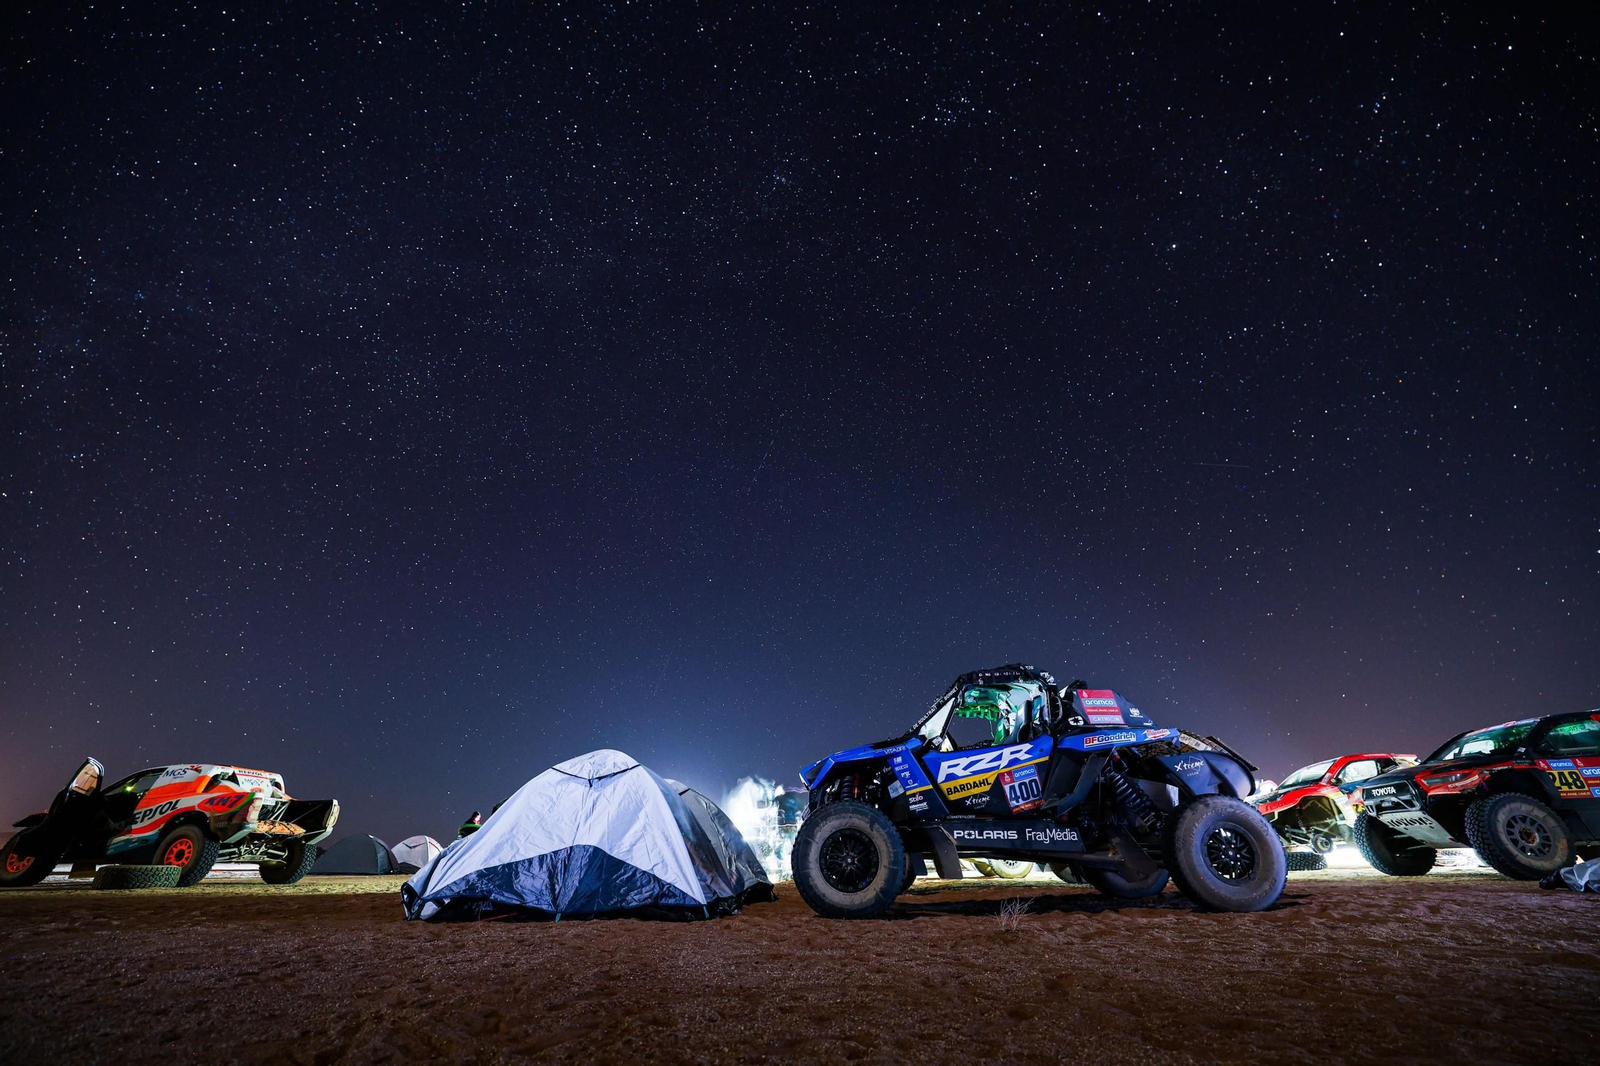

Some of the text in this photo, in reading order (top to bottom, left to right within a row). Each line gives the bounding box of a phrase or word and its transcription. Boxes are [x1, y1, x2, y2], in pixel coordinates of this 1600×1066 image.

[1084, 731, 1136, 745] BFGoodrich
[937, 743, 1034, 784] RZR
[162, 768, 189, 778] MGS
[1014, 768, 1035, 778] aramco
[946, 778, 992, 796] BARDAHL
[1008, 778, 1040, 804] 400
[1371, 786, 1397, 797] TOYOTA
[131, 799, 181, 824] EPSOL
[953, 828, 1078, 844] POLARIS FrayMédia
